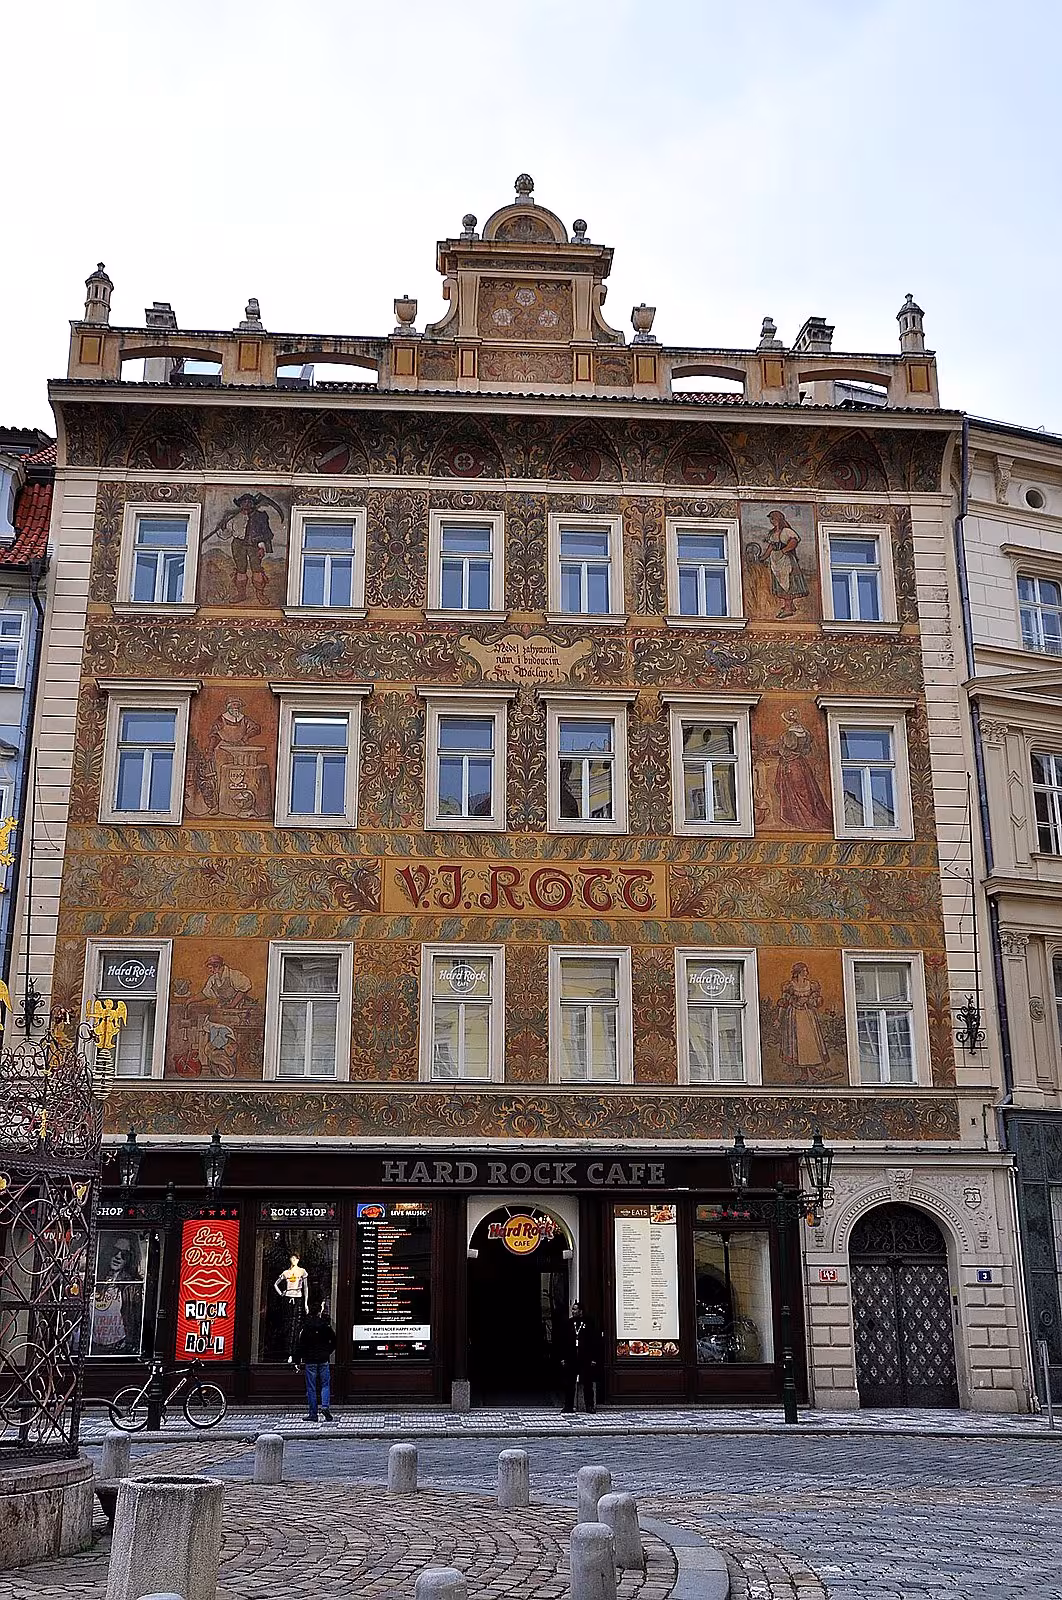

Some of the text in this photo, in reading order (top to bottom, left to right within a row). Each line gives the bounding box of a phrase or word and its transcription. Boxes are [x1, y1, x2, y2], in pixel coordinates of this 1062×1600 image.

[107, 965, 156, 978] Hard Rock
[439, 969, 486, 983] Hard Rock
[689, 973, 735, 986] Hard Rock
[381, 1160, 666, 1185] HARD ROCK CAFE
[270, 1208, 327, 1217] ROCK SHOP
[193, 1226, 227, 1247] Eat,
[488, 1222, 554, 1240] Hard Rock
[184, 1246, 234, 1266] Drink
[184, 1300, 228, 1320] ROCK
[184, 1332, 224, 1354] ROLL
